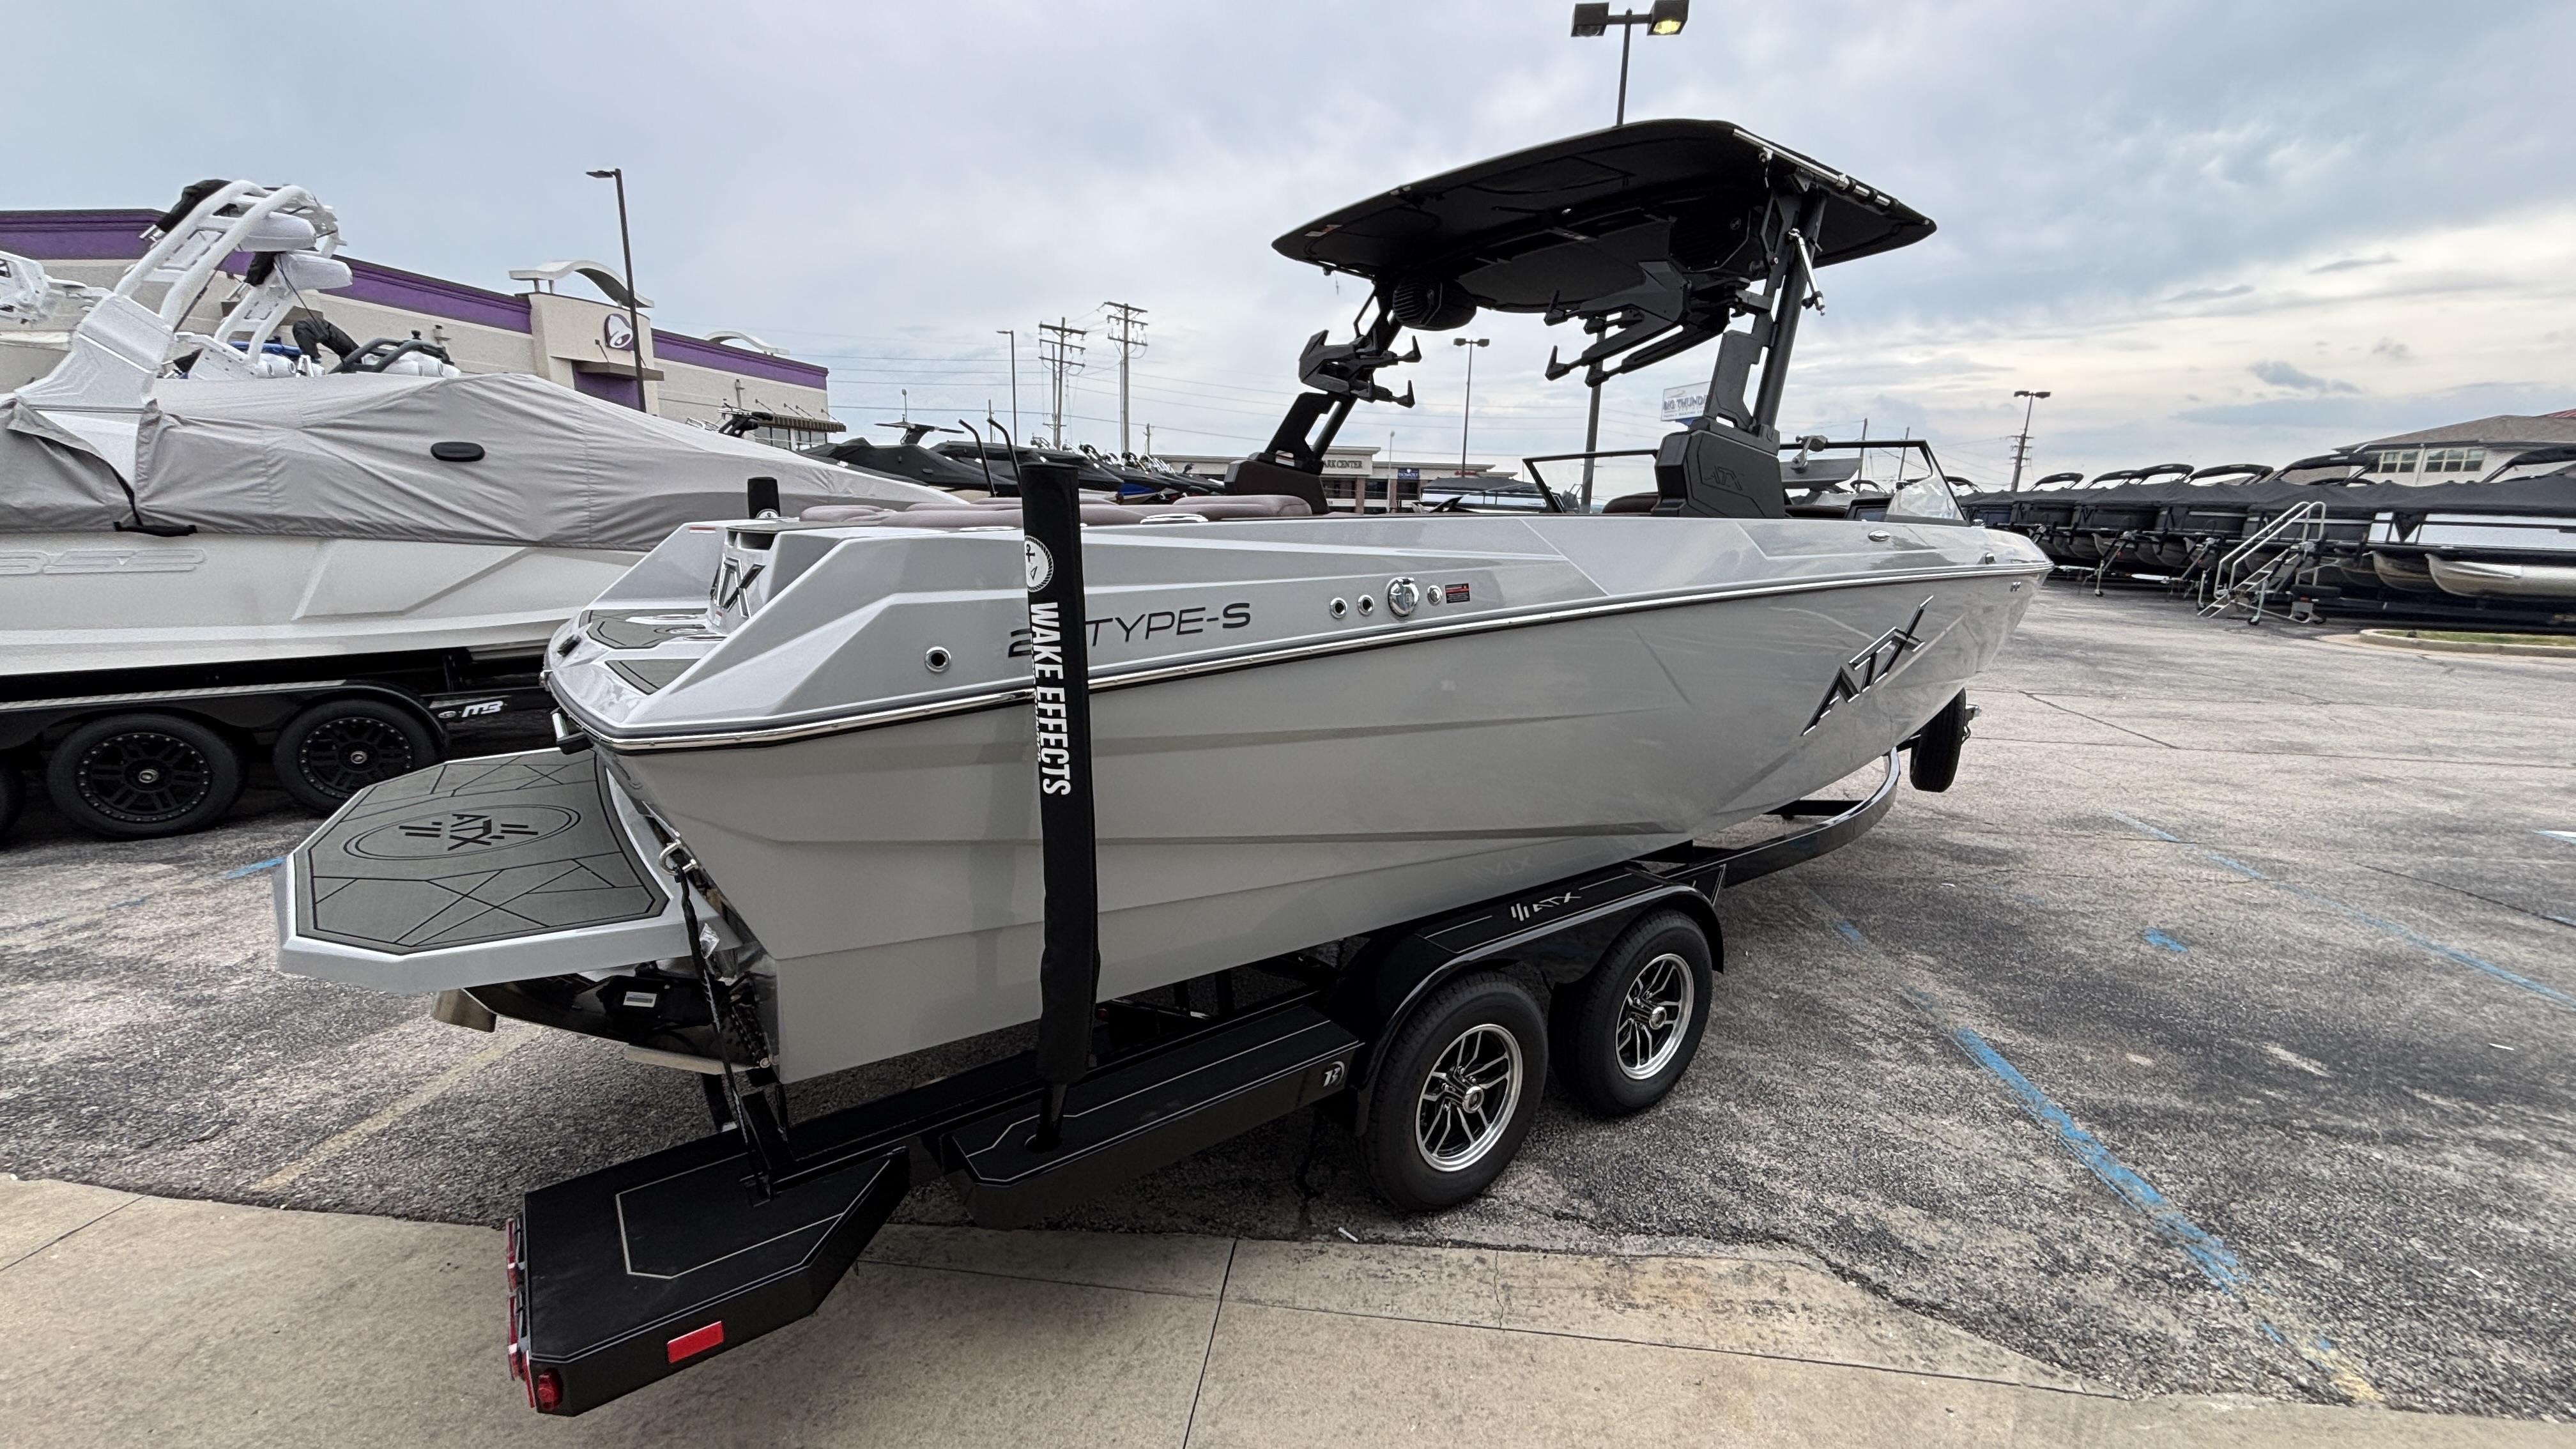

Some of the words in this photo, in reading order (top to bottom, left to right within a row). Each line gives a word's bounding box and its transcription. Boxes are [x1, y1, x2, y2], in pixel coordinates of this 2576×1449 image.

[1323, 459, 1336, 468] ARK
[1337, 460, 1363, 468] CENTER
[1031, 602, 1063, 679] WAKE
[1085, 602, 1250, 647] TYPE-S
[1800, 595, 1934, 737] ATX
[1036, 686, 1071, 795] EFFECTS
[447, 813, 492, 851] ATX
[1532, 892, 1582, 912] ATX
